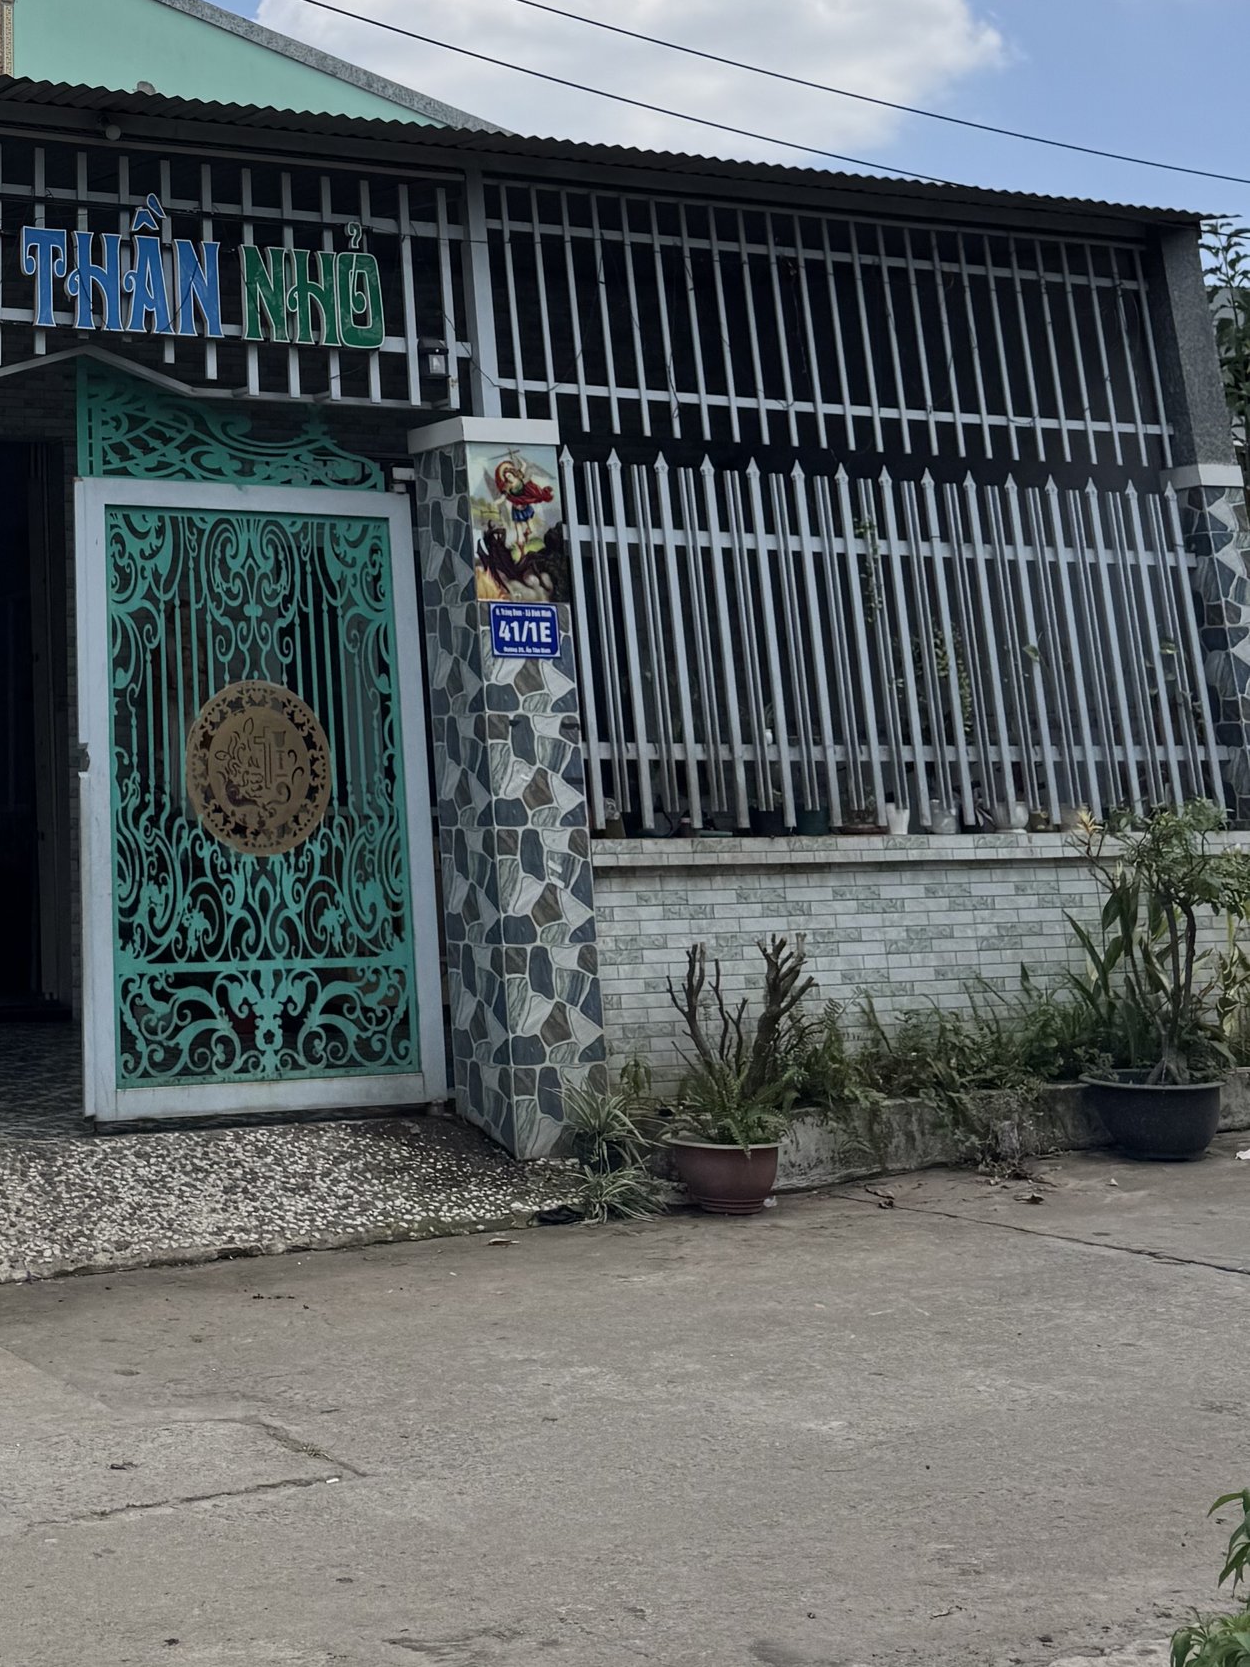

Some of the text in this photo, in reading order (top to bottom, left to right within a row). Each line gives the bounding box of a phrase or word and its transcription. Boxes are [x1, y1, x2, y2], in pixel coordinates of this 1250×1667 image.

[21, 193, 225, 338] THẦN
[238, 222, 385, 349] NHỎ
[499, 620, 552, 643] 41/1E
